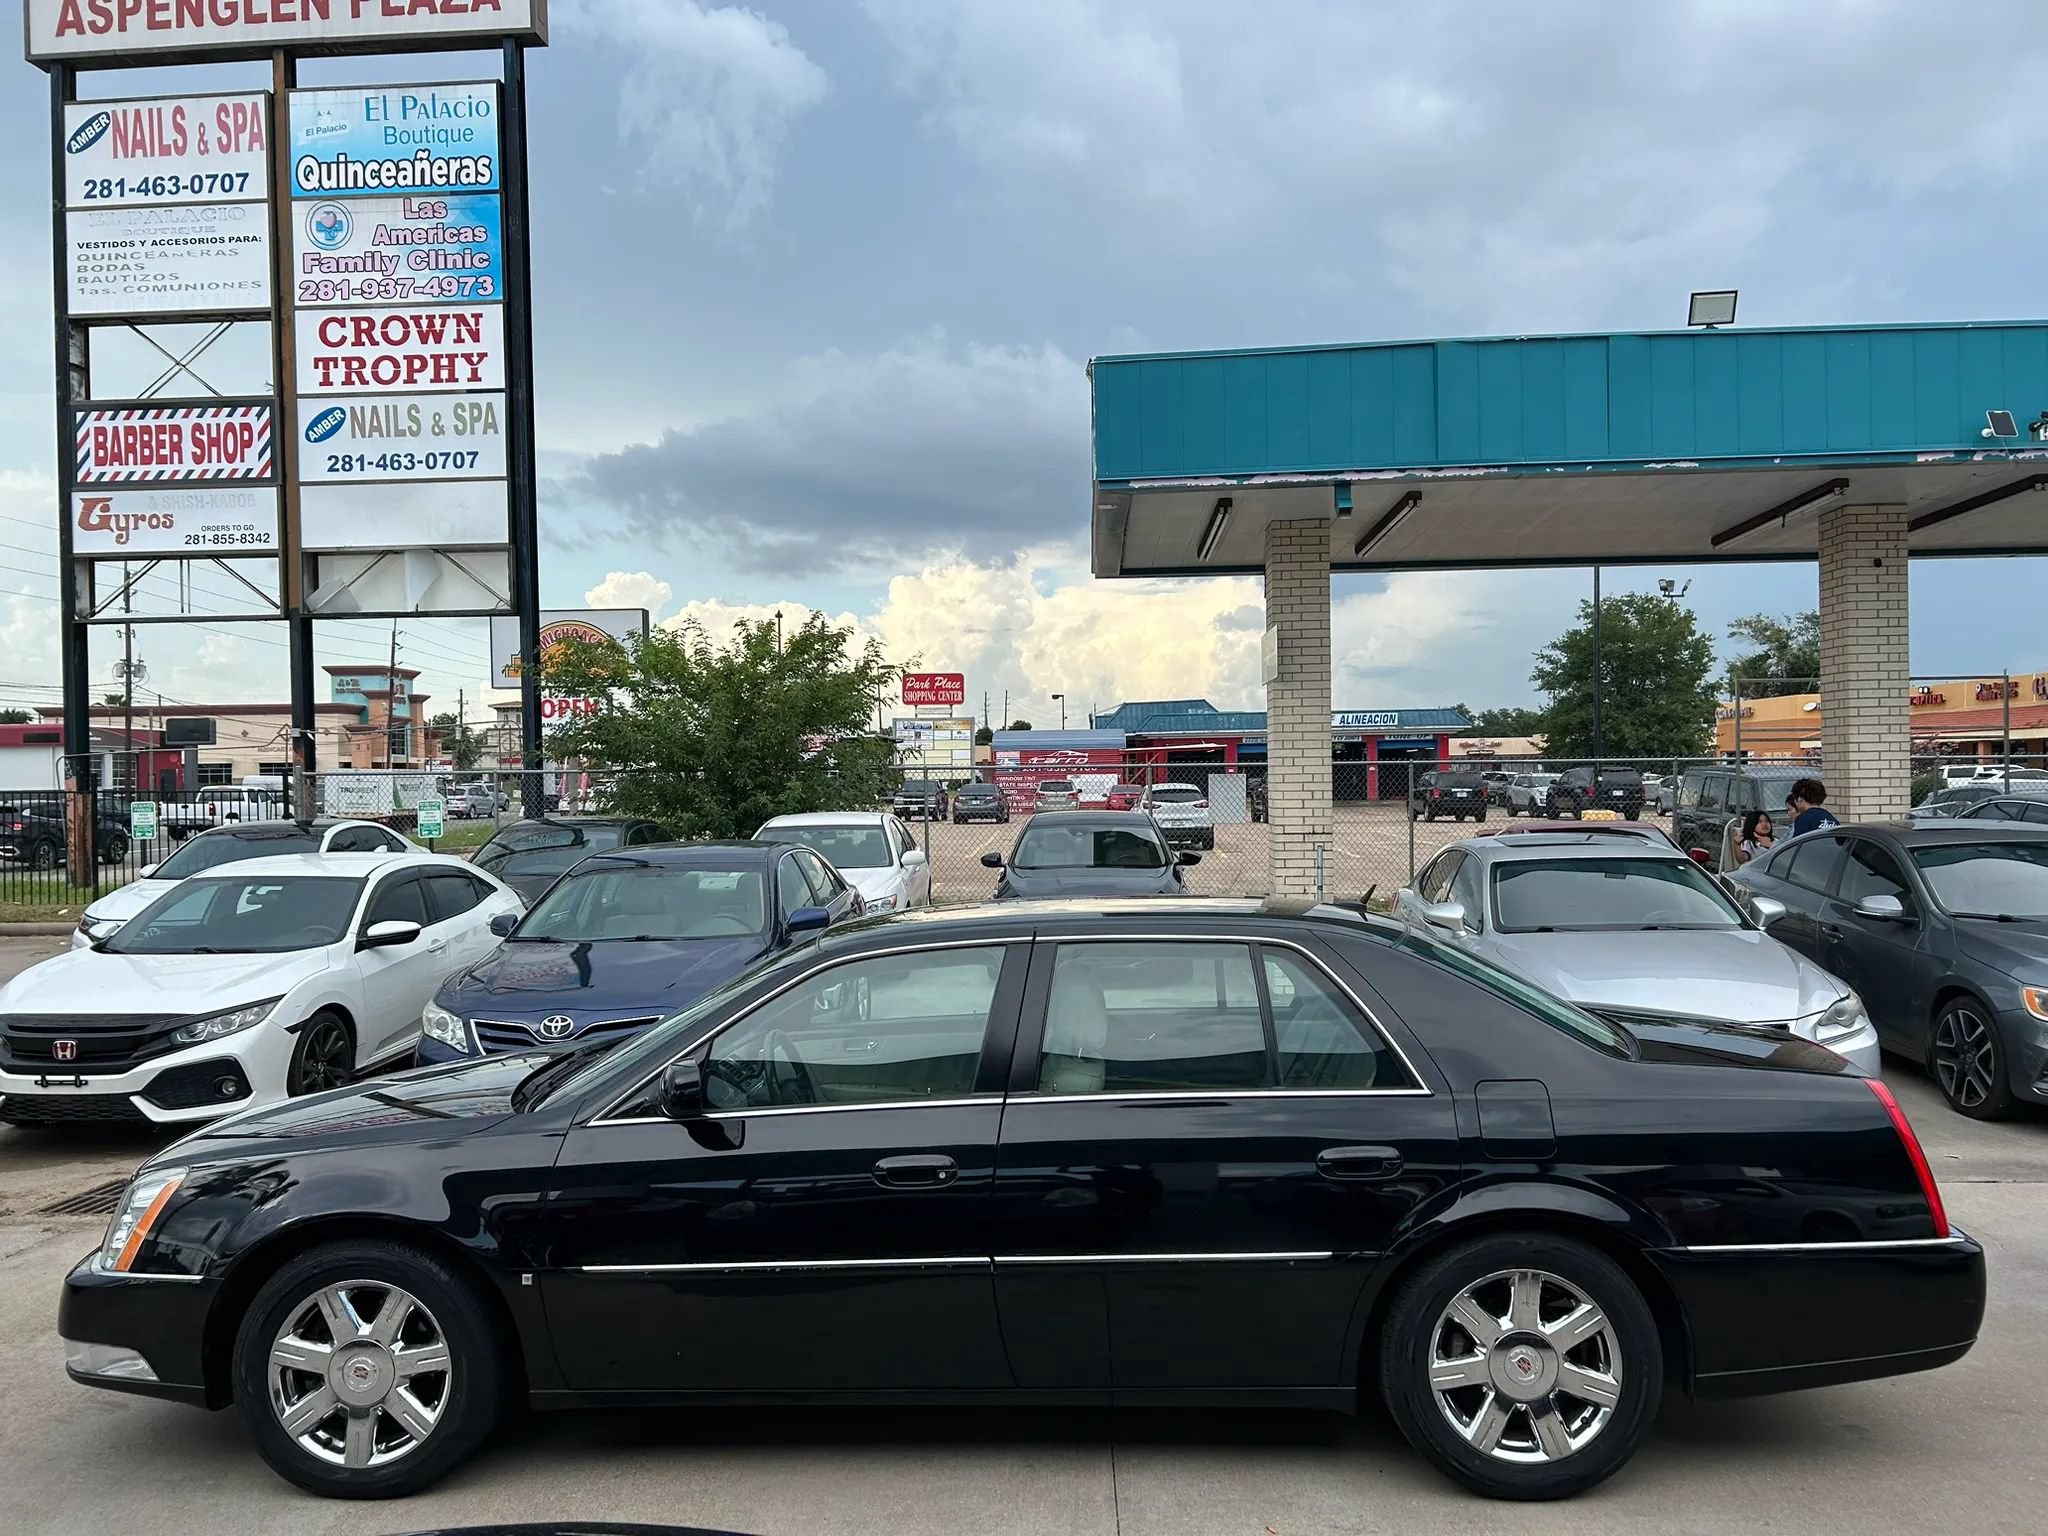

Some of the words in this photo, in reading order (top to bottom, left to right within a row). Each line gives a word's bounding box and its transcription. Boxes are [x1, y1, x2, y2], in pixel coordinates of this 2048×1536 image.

[365, 94, 390, 122] El
[401, 92, 491, 121] Palacio
[70, 113, 110, 153] AMBER
[111, 104, 188, 160] NAILS
[198, 121, 209, 157] &
[215, 101, 265, 155] SPA
[305, 127, 315, 137] El
[316, 123, 347, 135] Palacio
[383, 124, 474, 148] Boutique
[296, 148, 492, 192] Quinceañeras
[83, 172, 250, 200] 281-463-0707
[127, 206, 246, 225] PALACIO
[403, 198, 448, 220] Las
[77, 240, 135, 250] VESTIDOS
[139, 239, 147, 248] Y
[150, 236, 226, 247] ACCESORIOS
[228, 235, 262, 244] PARA:
[372, 222, 488, 247] Americas
[76, 262, 146, 273] BODAS
[302, 251, 400, 277] Family
[407, 248, 491, 272] Clinic
[77, 272, 180, 285] BAUTIZOS
[77, 286, 117, 296] 1as.
[123, 280, 262, 294] COMUNIONES
[299, 274, 495, 302] 281-937-4973
[318, 312, 484, 348] CROWN
[313, 352, 488, 387] TROPHY
[307, 409, 345, 442] AMBER
[349, 403, 422, 439] NAILS
[431, 411, 446, 437] &
[452, 401, 500, 437] SPA
[93, 424, 185, 467] BARBER
[190, 421, 254, 466] SHOP
[327, 451, 480, 473] 281-463-0707
[162, 492, 257, 511] SHISH-KABOB
[77, 497, 175, 546] Gyros
[201, 524, 230, 533] ORDERS
[232, 524, 242, 532] TO
[243, 524, 255, 532] GO
[184, 532, 271, 546] 281-855-8342
[905, 677, 931, 690] Park
[933, 676, 961, 690] Place
[904, 690, 936, 702] SHOPPING
[938, 690, 963, 702] CENTER
[1339, 713, 1397, 725] ALINEACION
